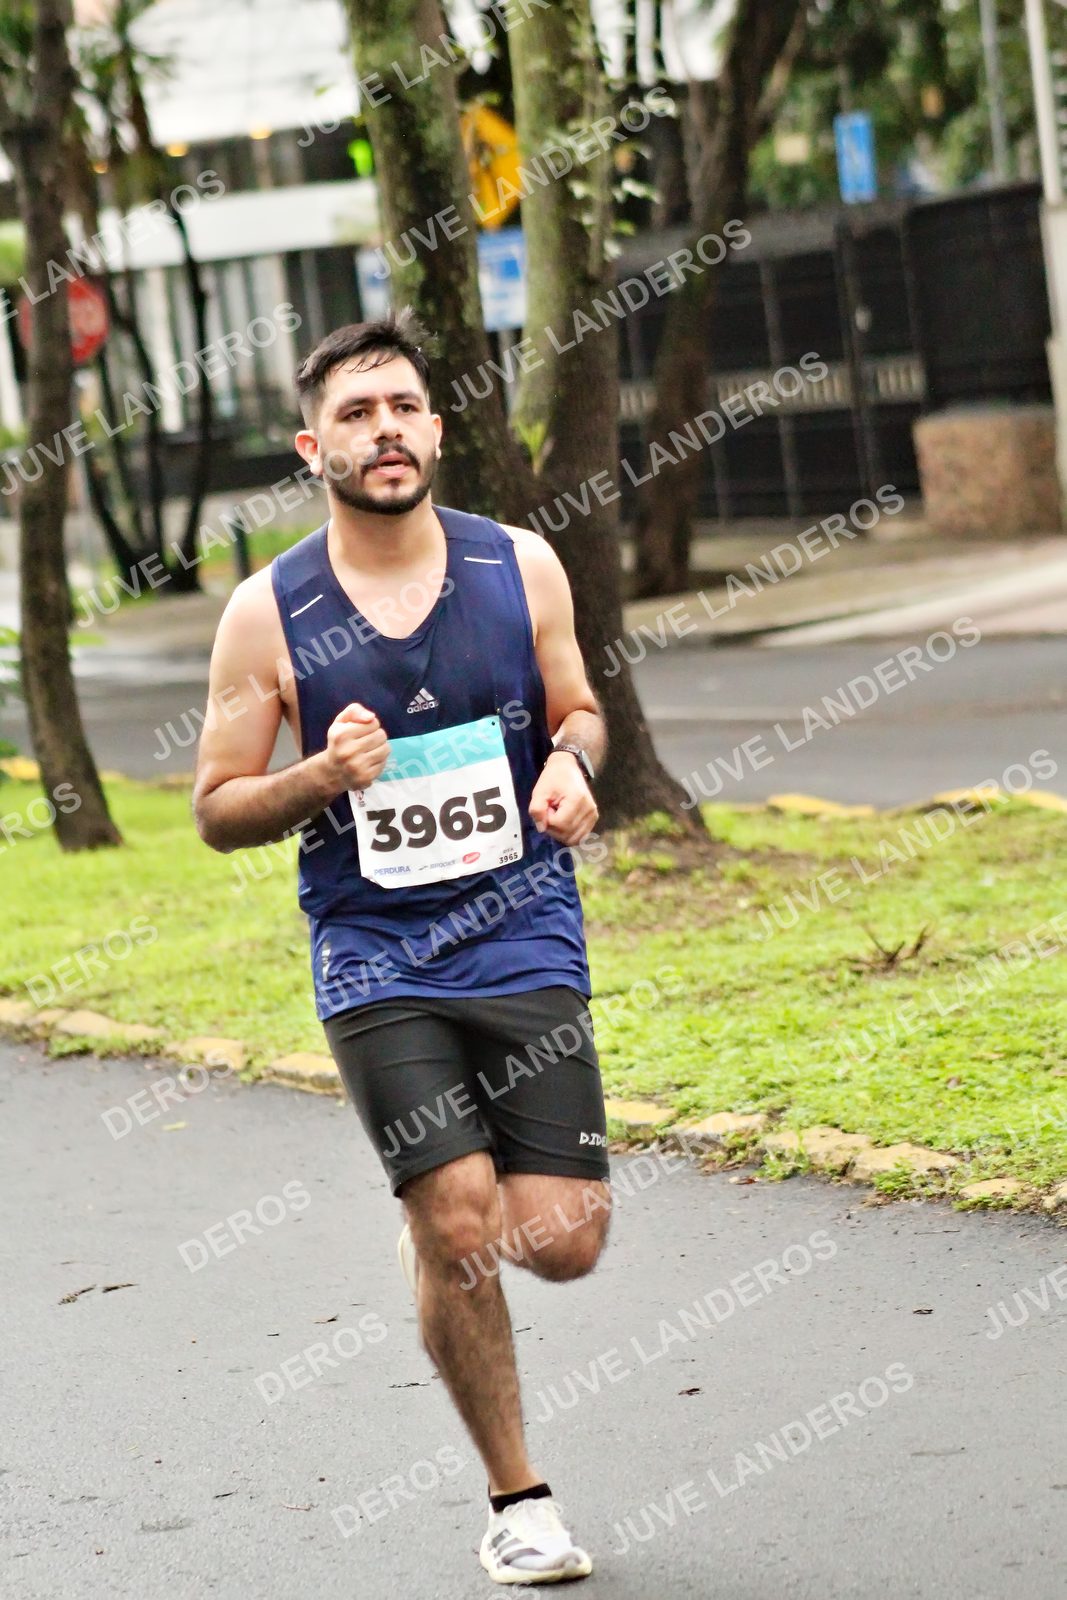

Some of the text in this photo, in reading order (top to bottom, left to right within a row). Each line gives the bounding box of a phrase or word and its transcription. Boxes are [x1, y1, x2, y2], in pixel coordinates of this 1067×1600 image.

[366, 786, 507, 852] 3965
[499, 852, 518, 864] 3965
[374, 865, 411, 876] PERDURA
